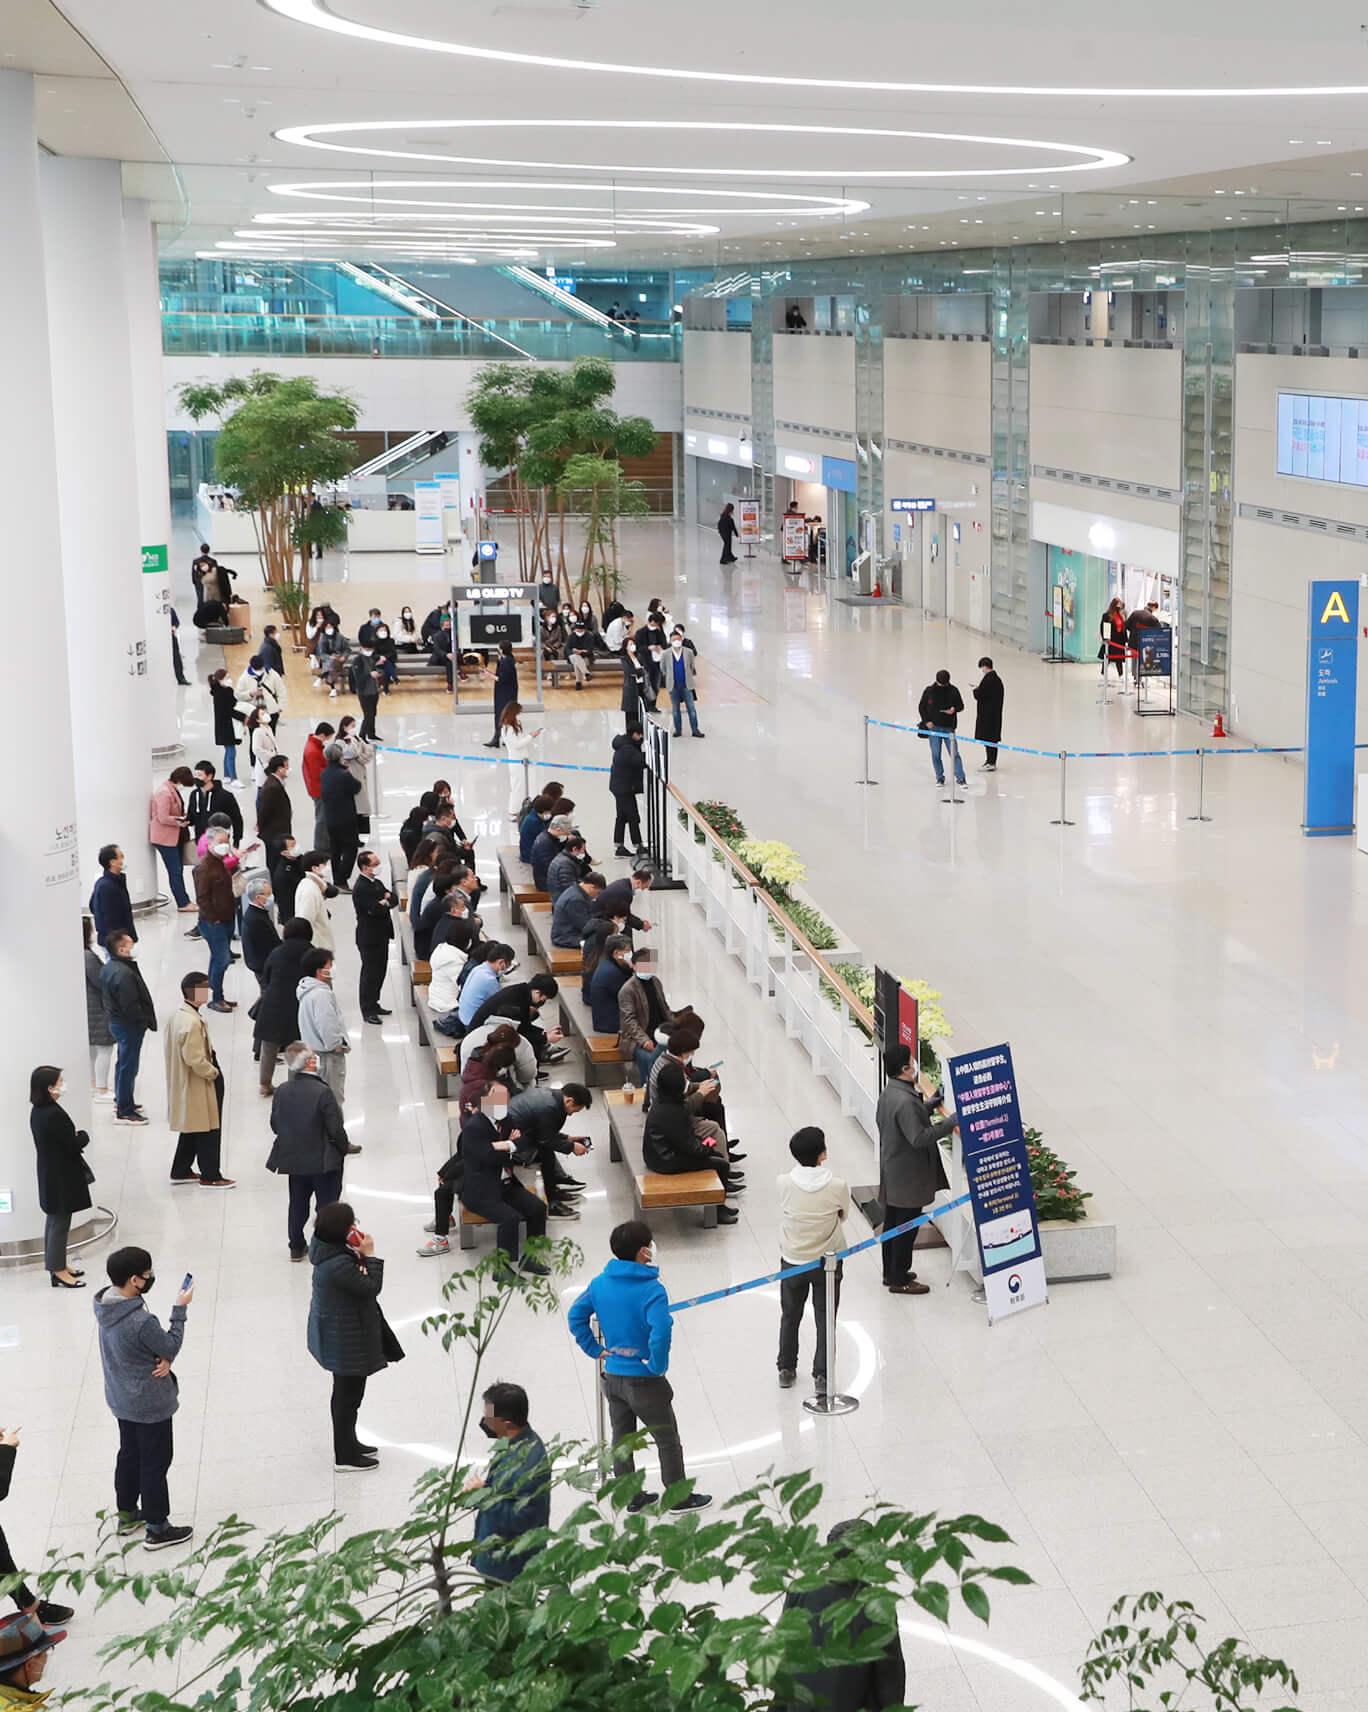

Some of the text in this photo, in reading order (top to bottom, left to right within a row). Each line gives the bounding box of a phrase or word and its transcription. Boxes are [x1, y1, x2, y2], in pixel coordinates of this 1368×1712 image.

[466, 588, 481, 599] LG
[509, 588, 524, 598] TV
[1320, 591, 1351, 624] A
[496, 625, 507, 633] LG
